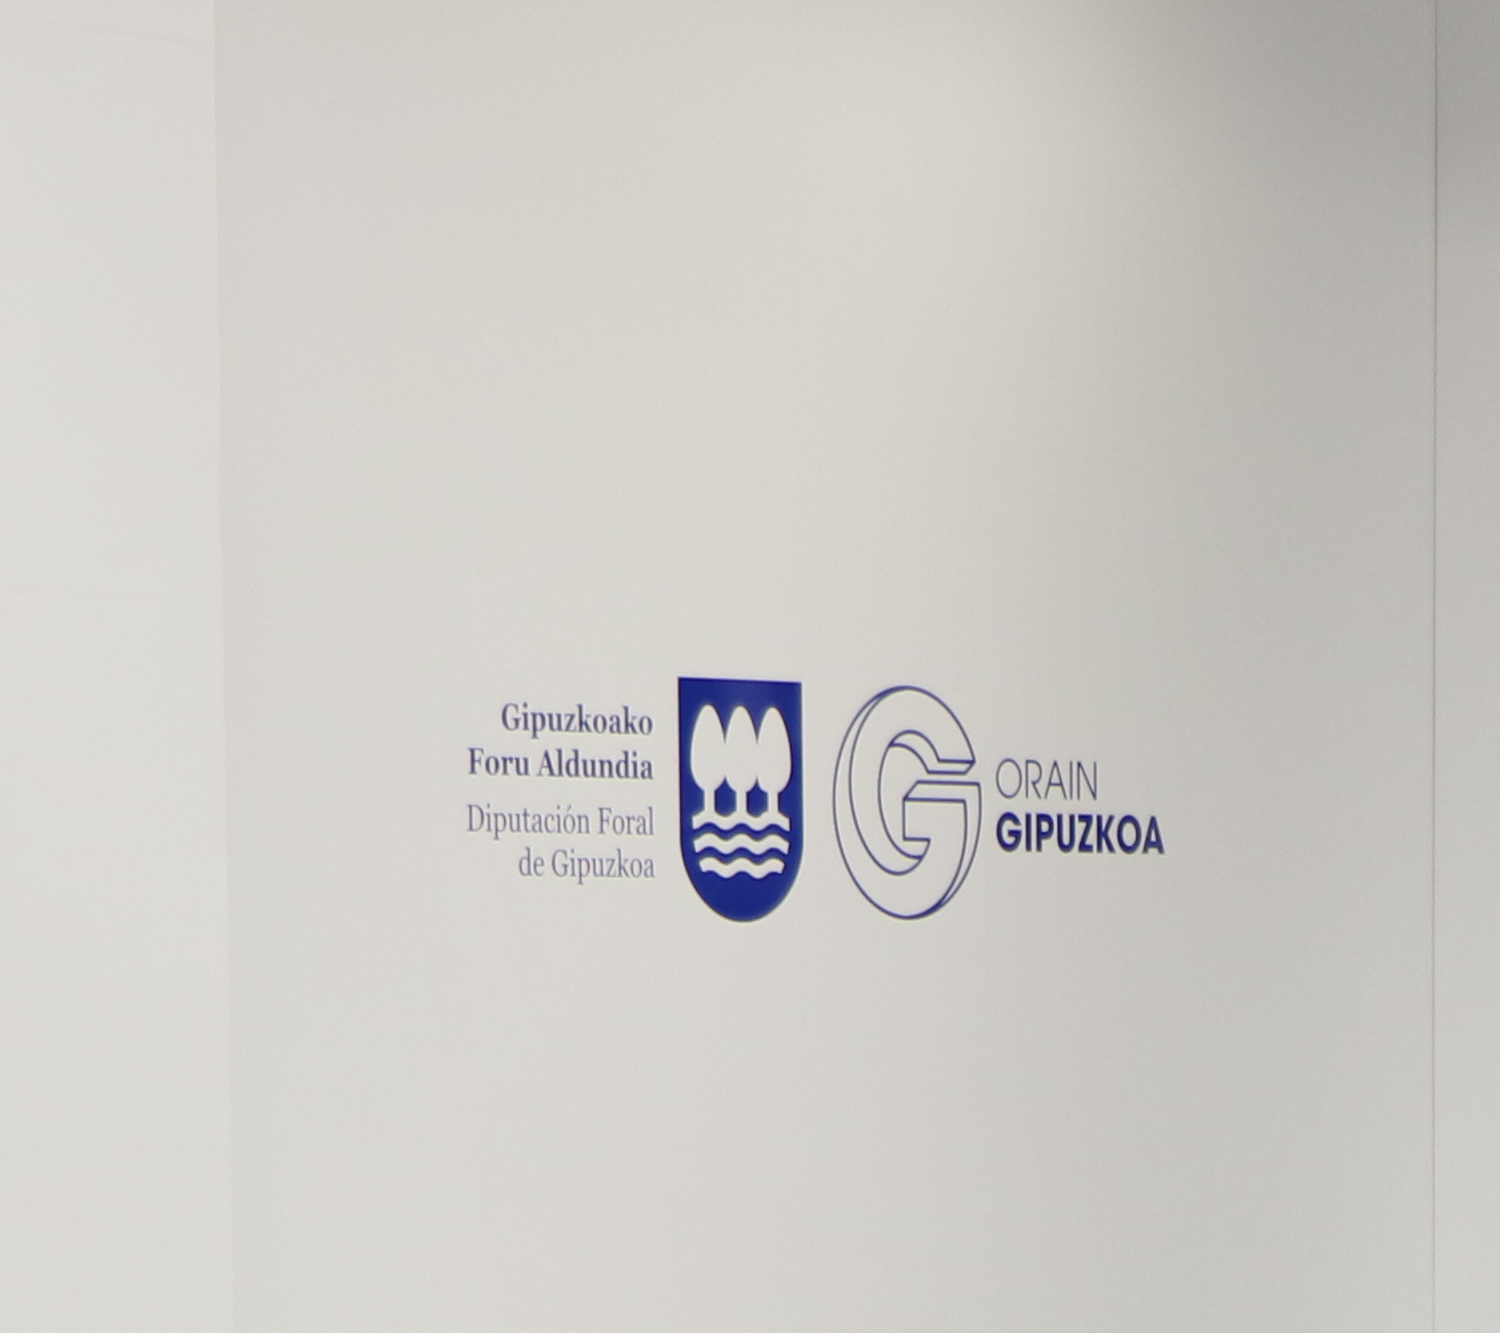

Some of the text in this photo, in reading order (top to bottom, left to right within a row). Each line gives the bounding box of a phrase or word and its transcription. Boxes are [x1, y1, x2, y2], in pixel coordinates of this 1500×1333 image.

[501, 702, 654, 739] Gipuzkoako
[468, 747, 654, 780] Foru Aldundia
[995, 757, 1098, 801] ORAIN
[467, 803, 655, 841] Diputación Foral
[995, 811, 1166, 855] GIPUZKOA
[518, 846, 655, 885] de Gipuzkoa
